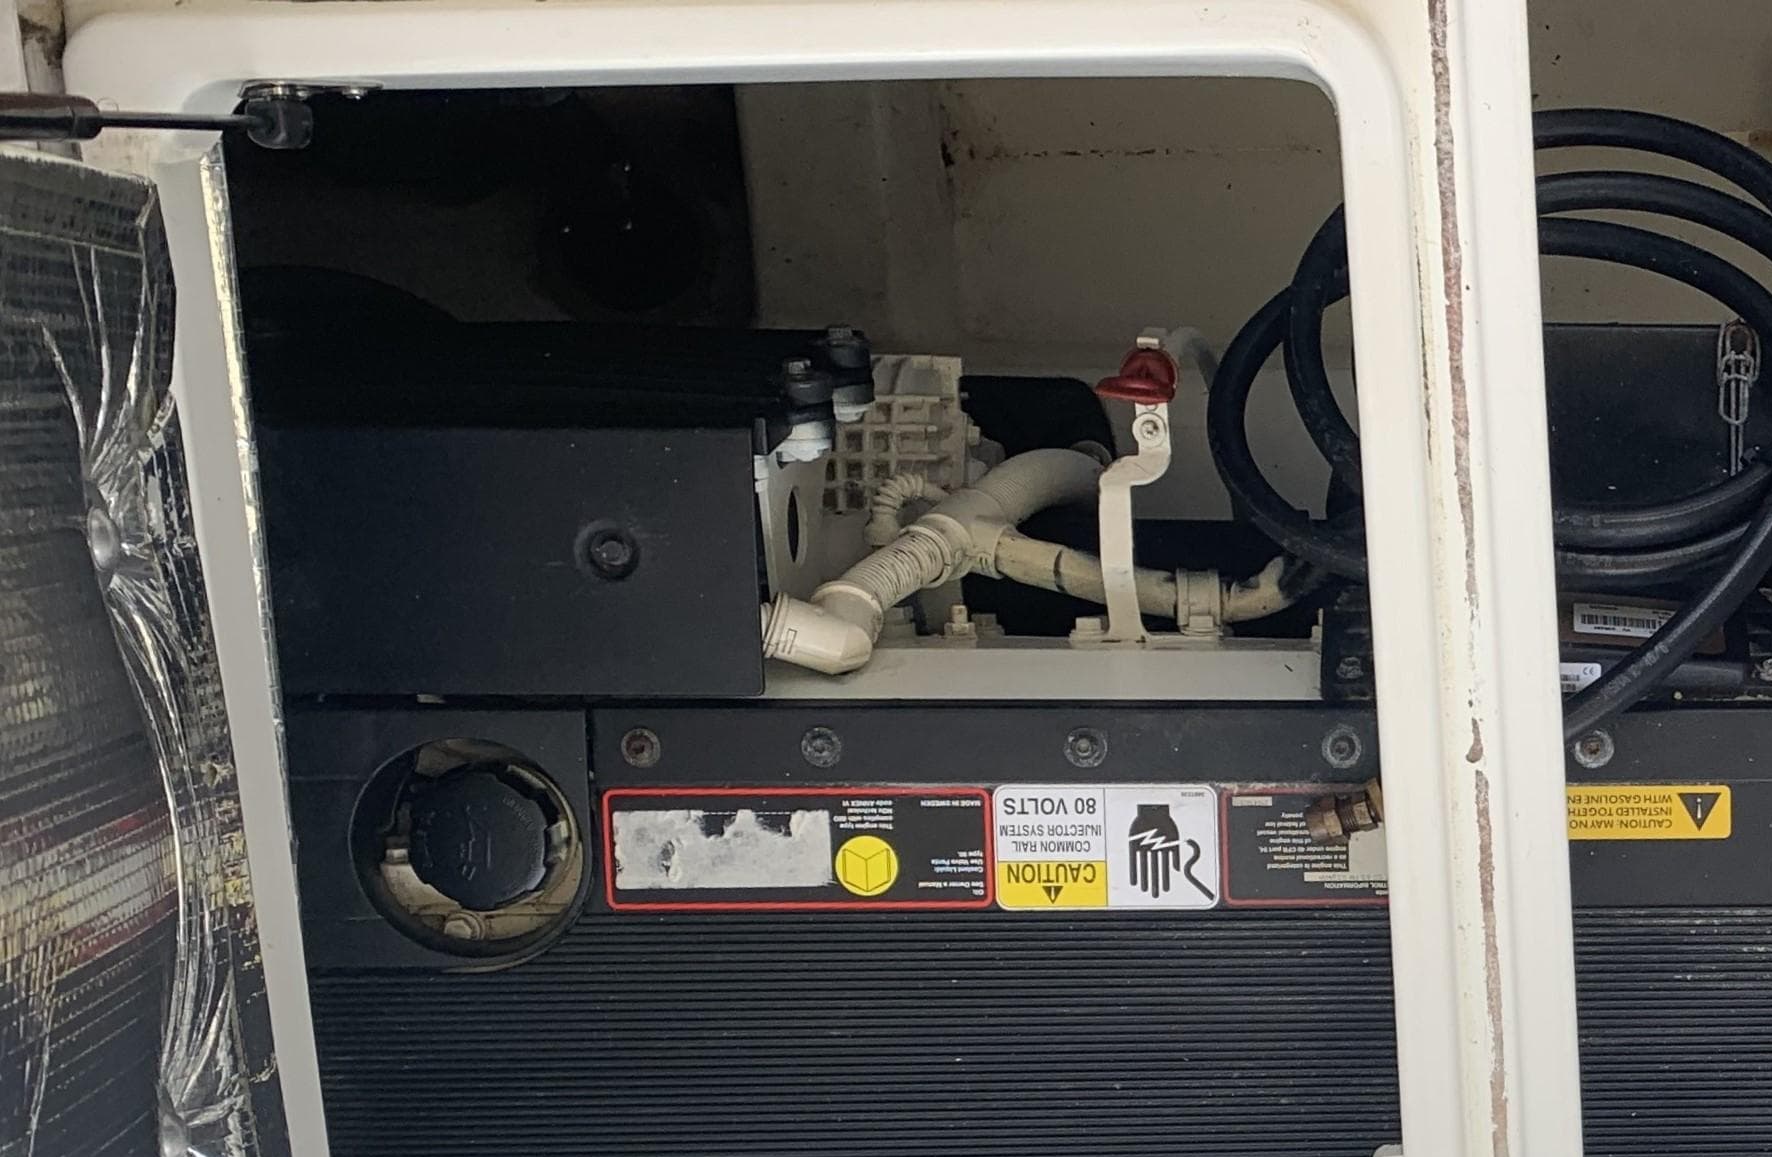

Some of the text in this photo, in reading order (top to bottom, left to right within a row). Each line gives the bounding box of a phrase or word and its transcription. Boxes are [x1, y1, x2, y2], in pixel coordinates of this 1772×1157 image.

[1583, 795, 1641, 804] GASOLINE
[1643, 795, 1672, 804] WITH
[1003, 798, 1096, 815] 80 VOLTS
[1568, 807, 1672, 817] INSTALLED TOGETH
[1569, 819, 1672, 829] CAUTION: MAY NO
[999, 824, 1102, 836] INJECTOR SYSTEM
[1011, 841, 1090, 852] COMMON RAIL
[1007, 864, 1096, 883] CAUTION
